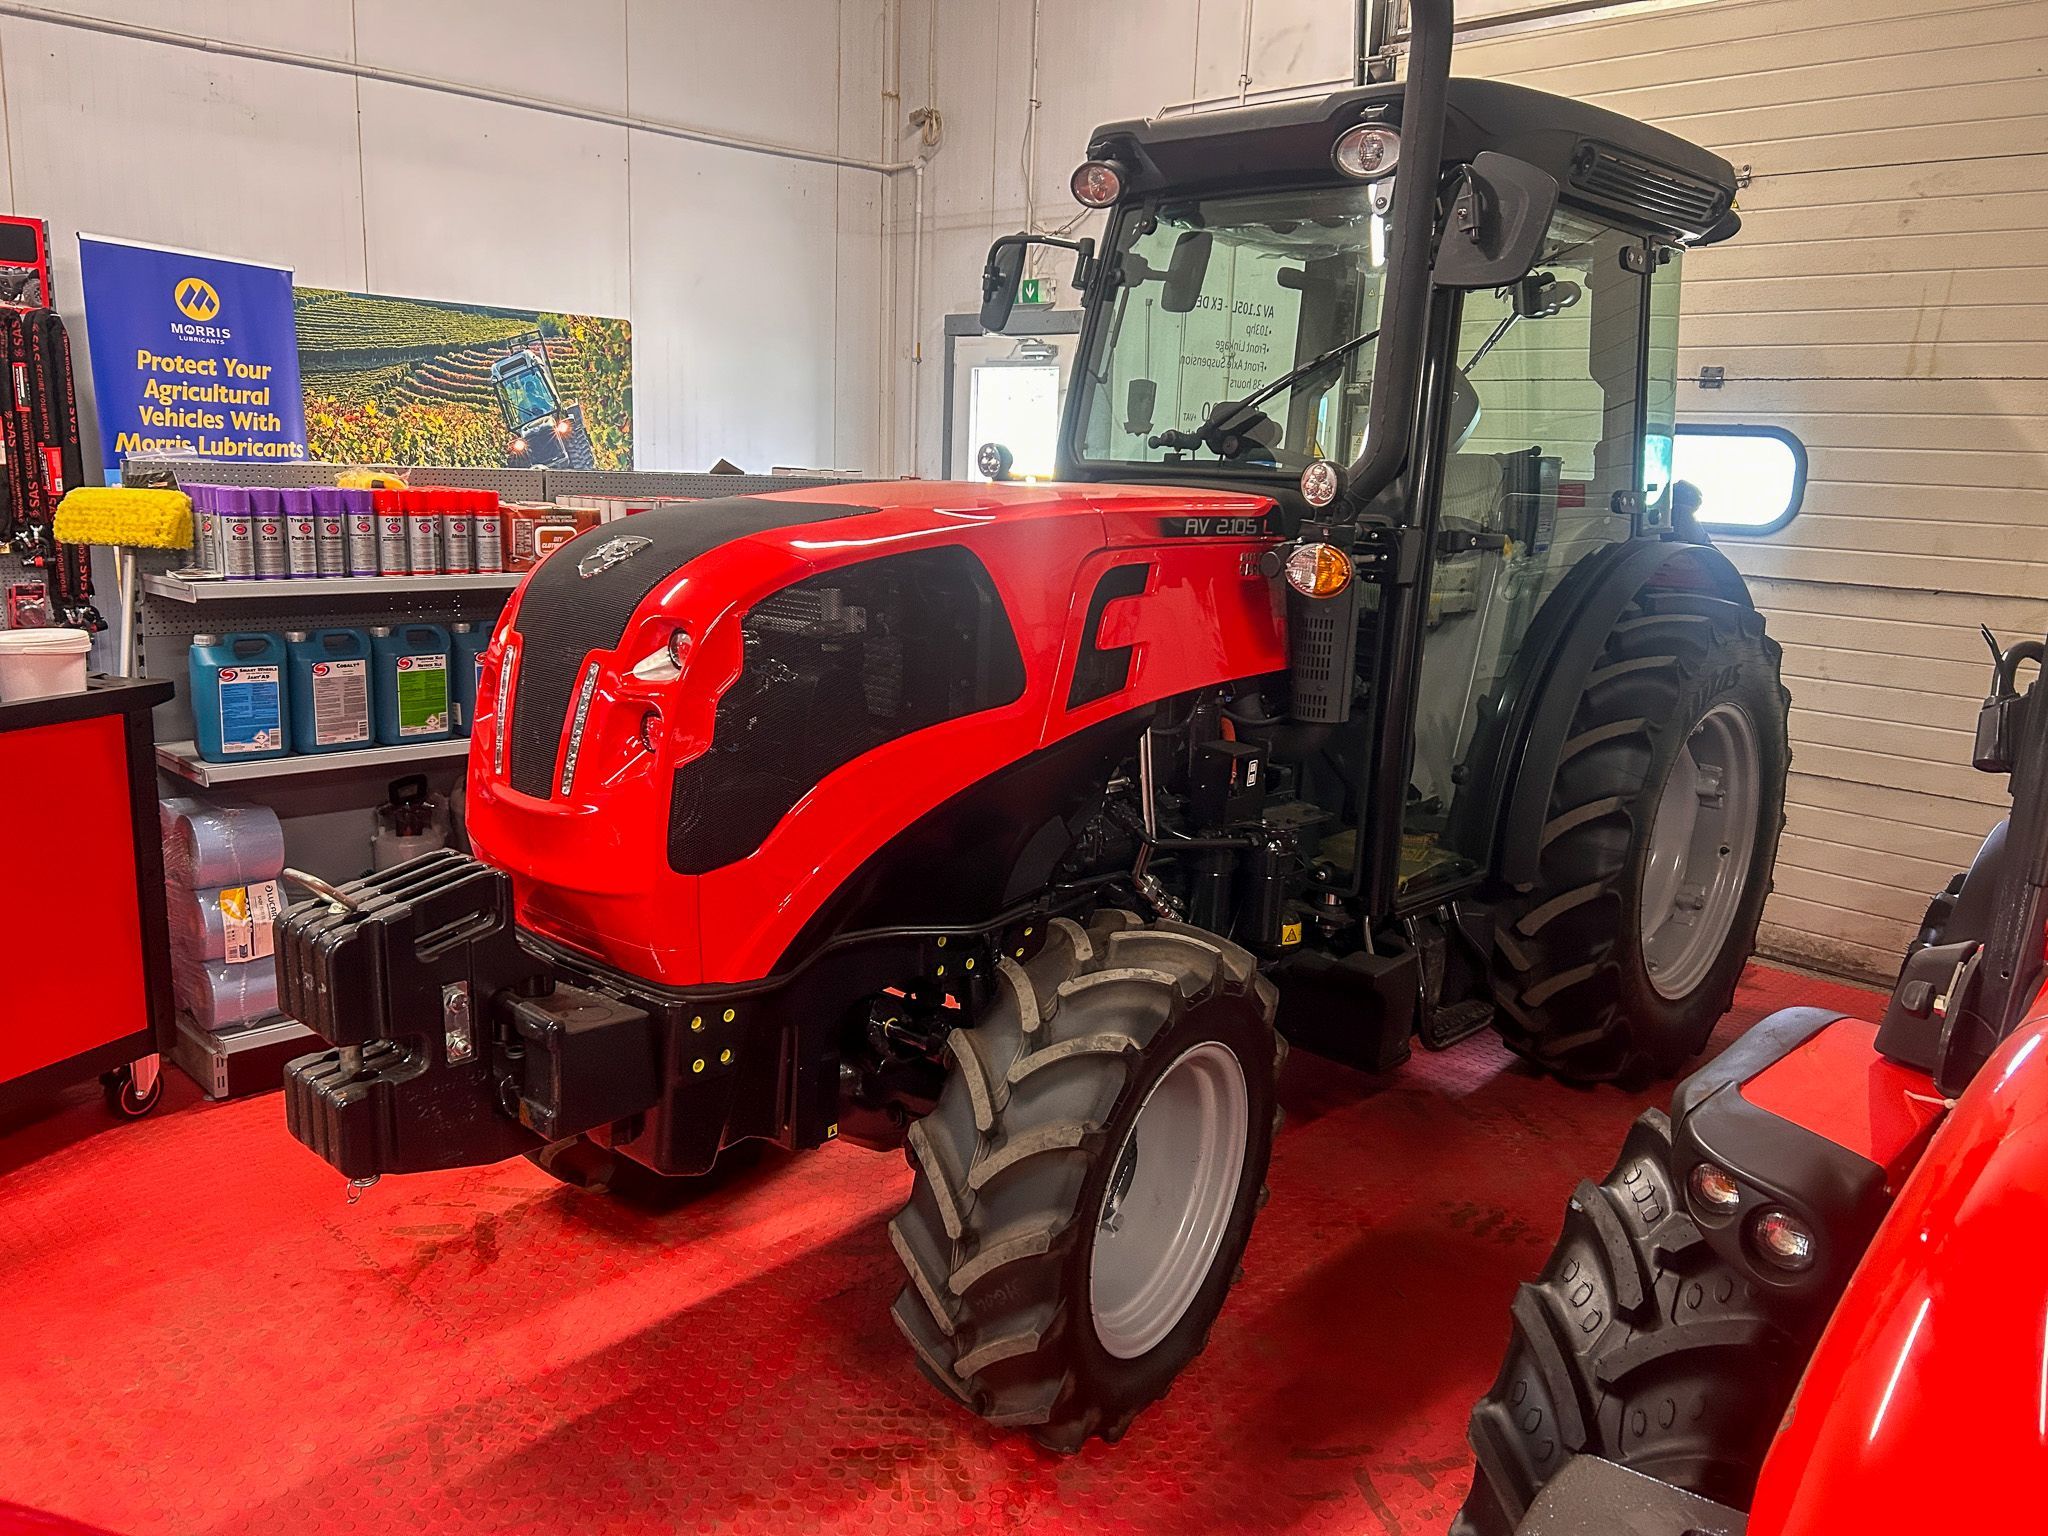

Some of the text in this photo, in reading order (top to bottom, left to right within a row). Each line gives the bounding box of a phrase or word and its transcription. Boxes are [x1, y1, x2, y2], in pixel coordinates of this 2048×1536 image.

[170, 322, 231, 339] MORRIS
[178, 335, 225, 345] LUBRICANTS
[137, 349, 272, 380] Protect Your
[143, 378, 270, 406] Agricultural
[138, 405, 281, 432] Vehicles With
[114, 431, 304, 458] Morris Lubricants
[28, 481, 40, 507] SAS
[1184, 518, 1273, 535] AV 2.105 L
[266, 892, 278, 918] LUCAR
